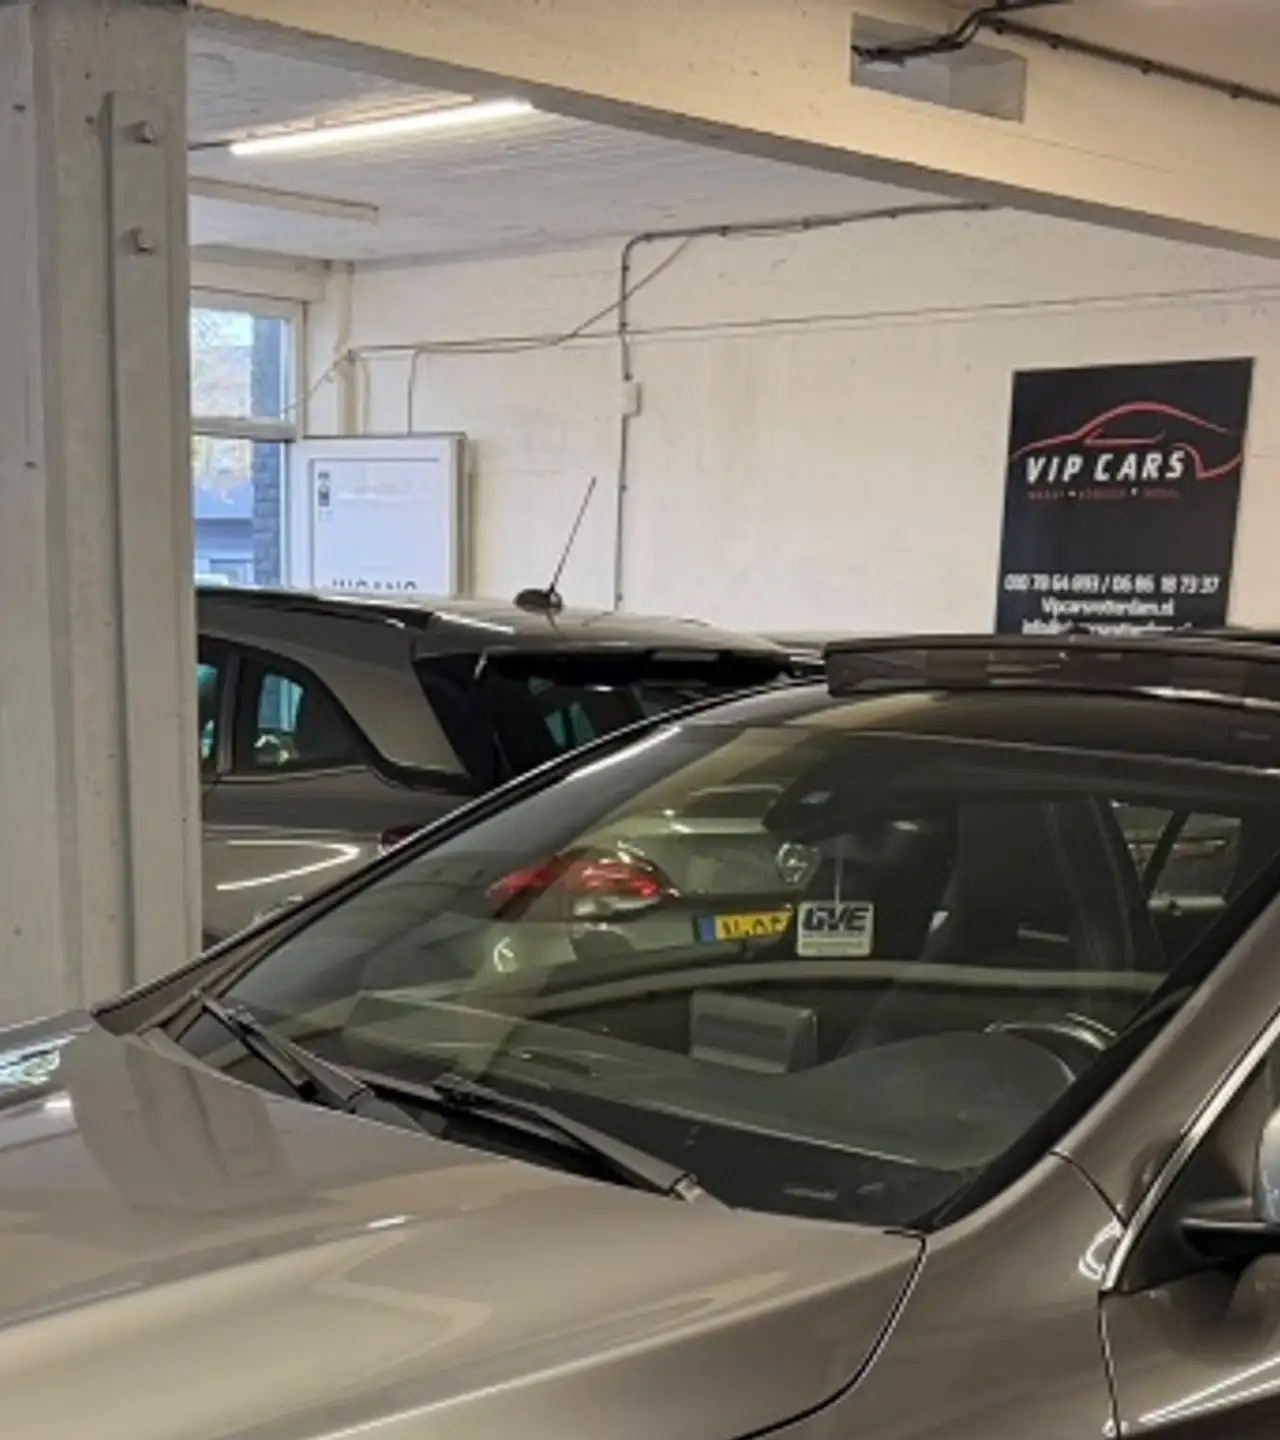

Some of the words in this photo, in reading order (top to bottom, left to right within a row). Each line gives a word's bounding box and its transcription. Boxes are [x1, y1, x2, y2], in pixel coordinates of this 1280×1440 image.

[1026, 453, 1084, 485] VIP
[1093, 450, 1185, 483] CARS
[802, 906, 870, 932] GVE
